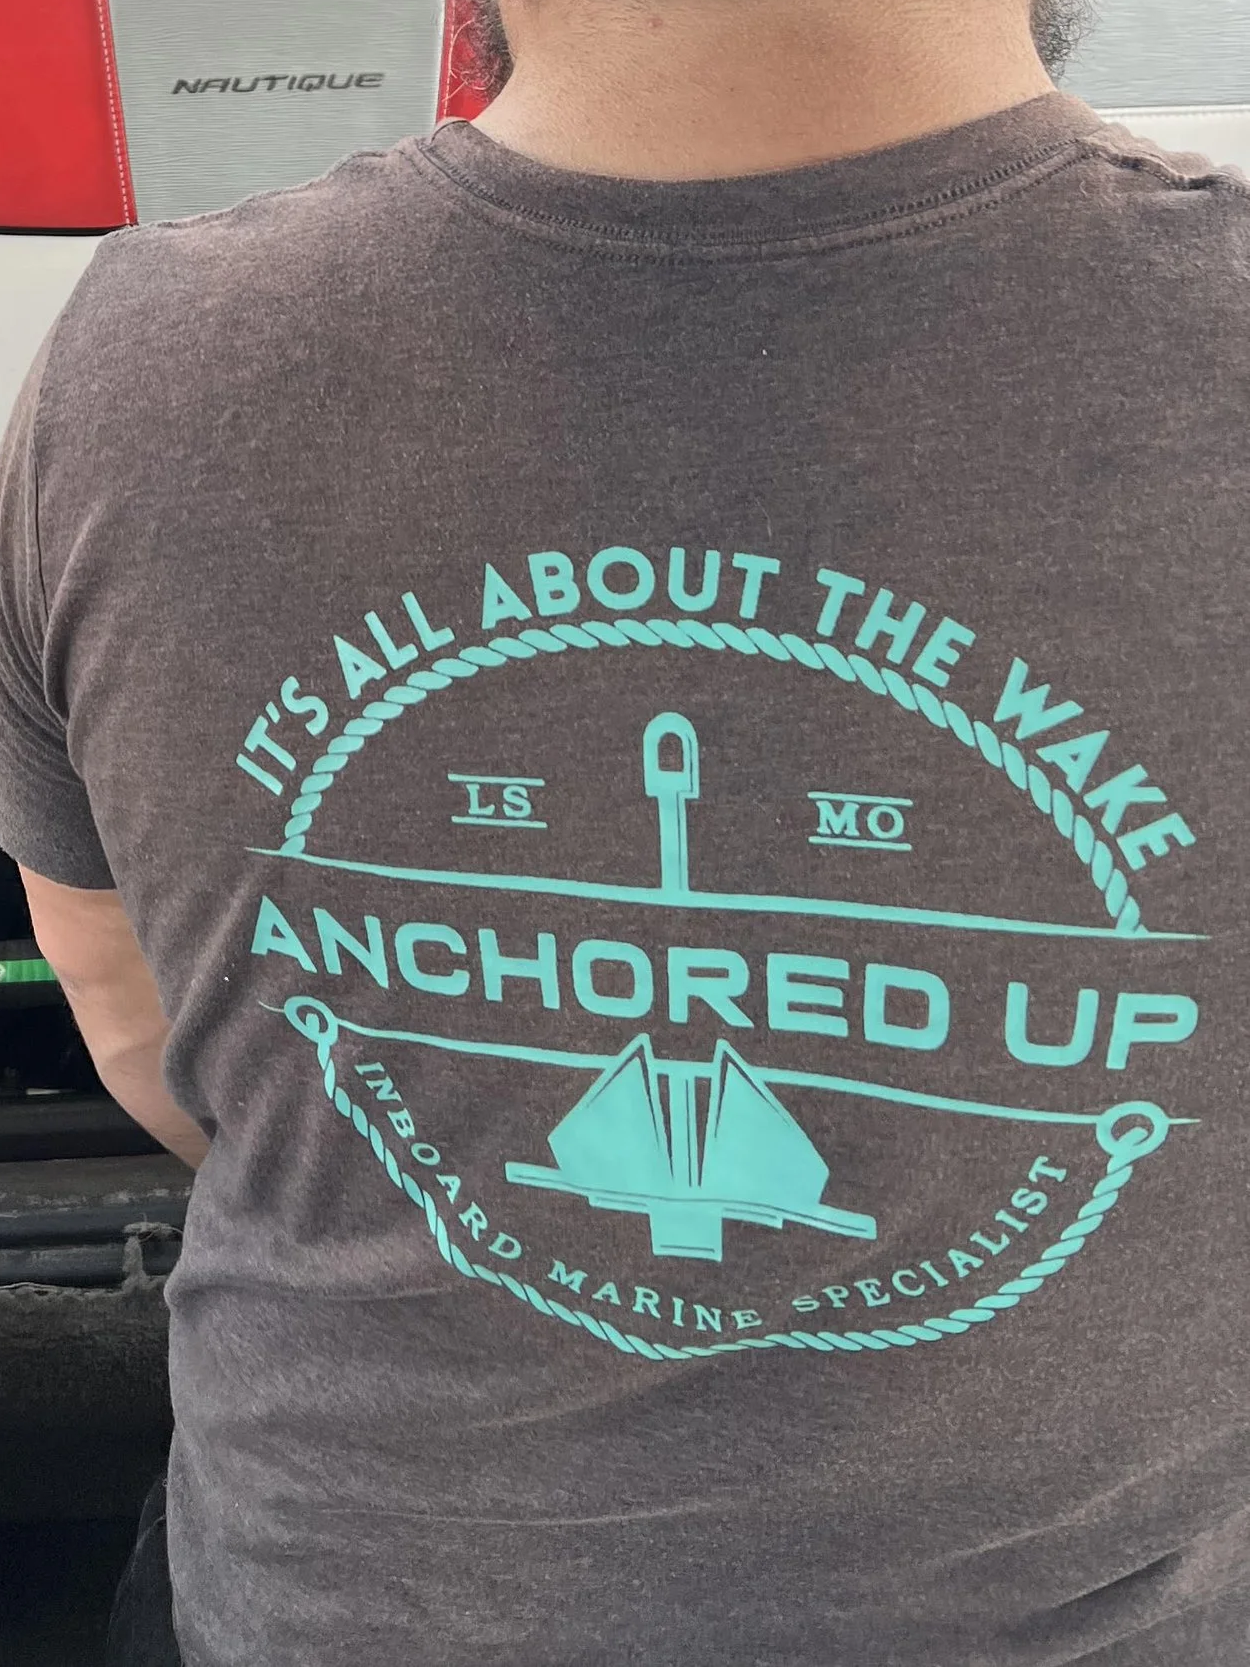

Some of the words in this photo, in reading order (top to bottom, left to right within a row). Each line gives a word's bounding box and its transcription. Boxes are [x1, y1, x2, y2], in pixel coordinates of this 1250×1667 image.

[171, 72, 386, 95] NAUTIQUE
[236, 678, 328, 794] IT'S
[333, 594, 454, 698] ALL
[480, 546, 781, 632] ABOUT
[815, 569, 975, 687] THE
[994, 660, 1196, 872] WAKE
[464, 783, 534, 821] LS
[817, 800, 902, 839] MO
[250, 896, 951, 1052] ANCHORED
[1005, 982, 1200, 1071] UP
[356, 1061, 524, 1260] INBOARD
[550, 1258, 761, 1332] MARINE
[794, 1155, 1069, 1313] SPECIALIST
